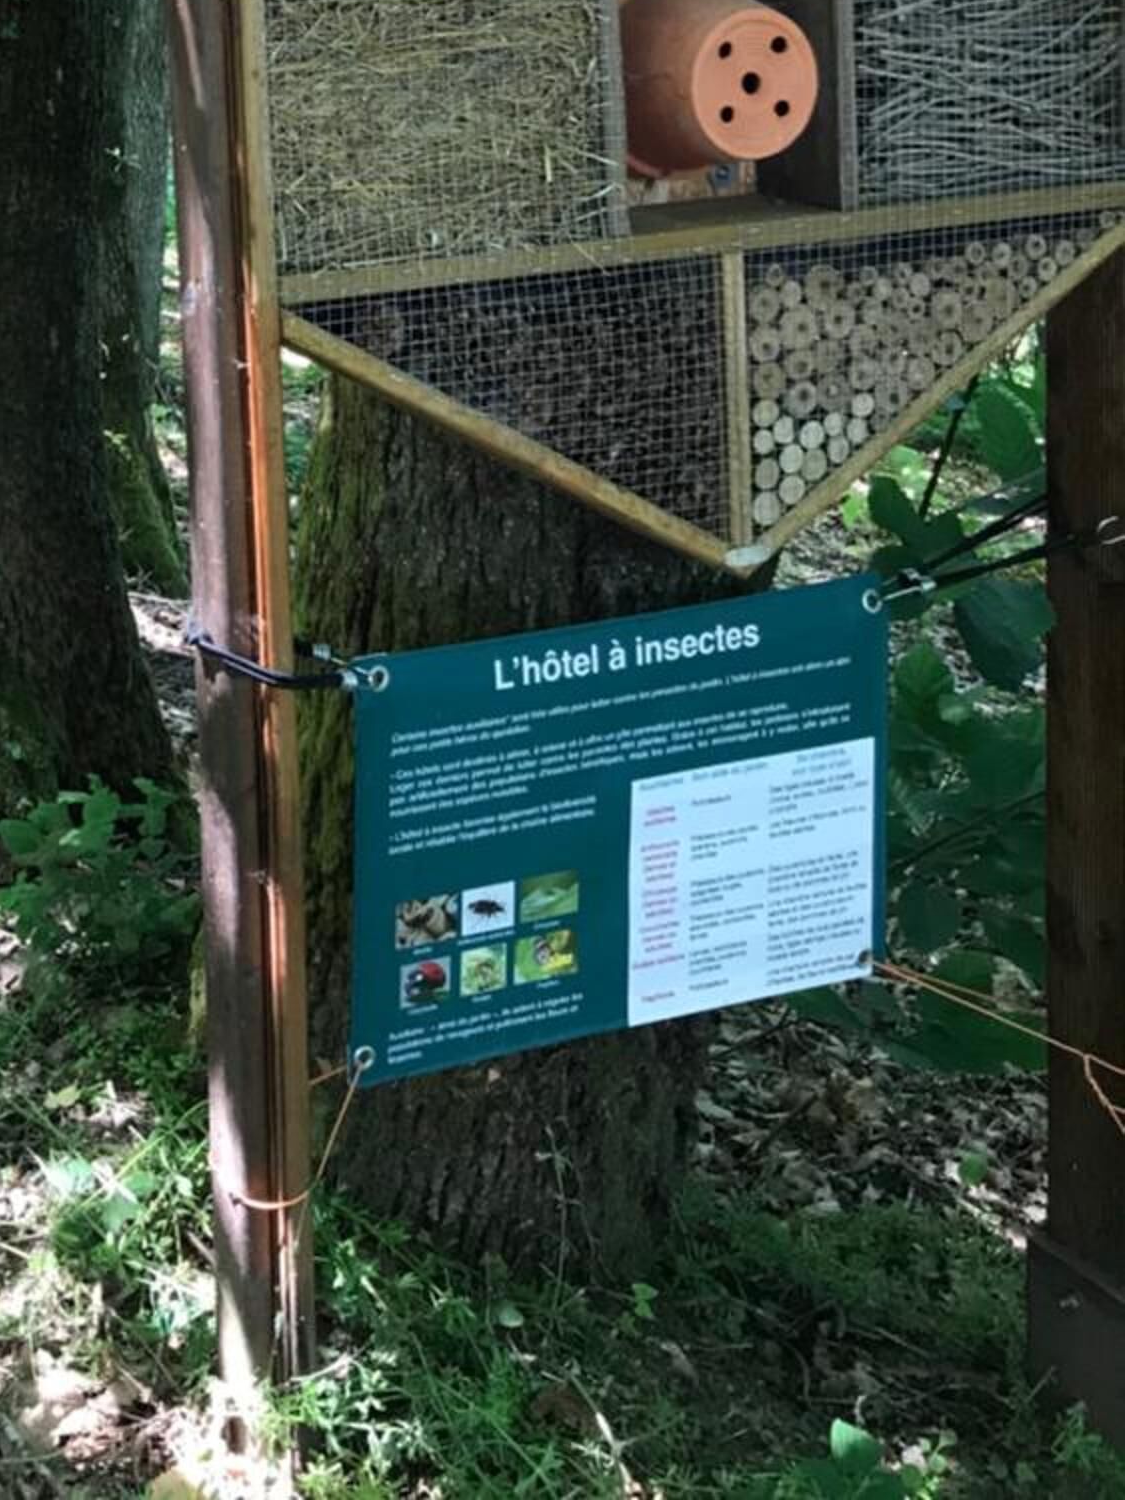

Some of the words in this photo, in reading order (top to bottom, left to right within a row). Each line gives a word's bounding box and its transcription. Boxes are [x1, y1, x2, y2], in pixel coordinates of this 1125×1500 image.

[493, 644, 600, 690] L'hôtel
[608, 638, 627, 671] à
[635, 623, 761, 667] insectes
